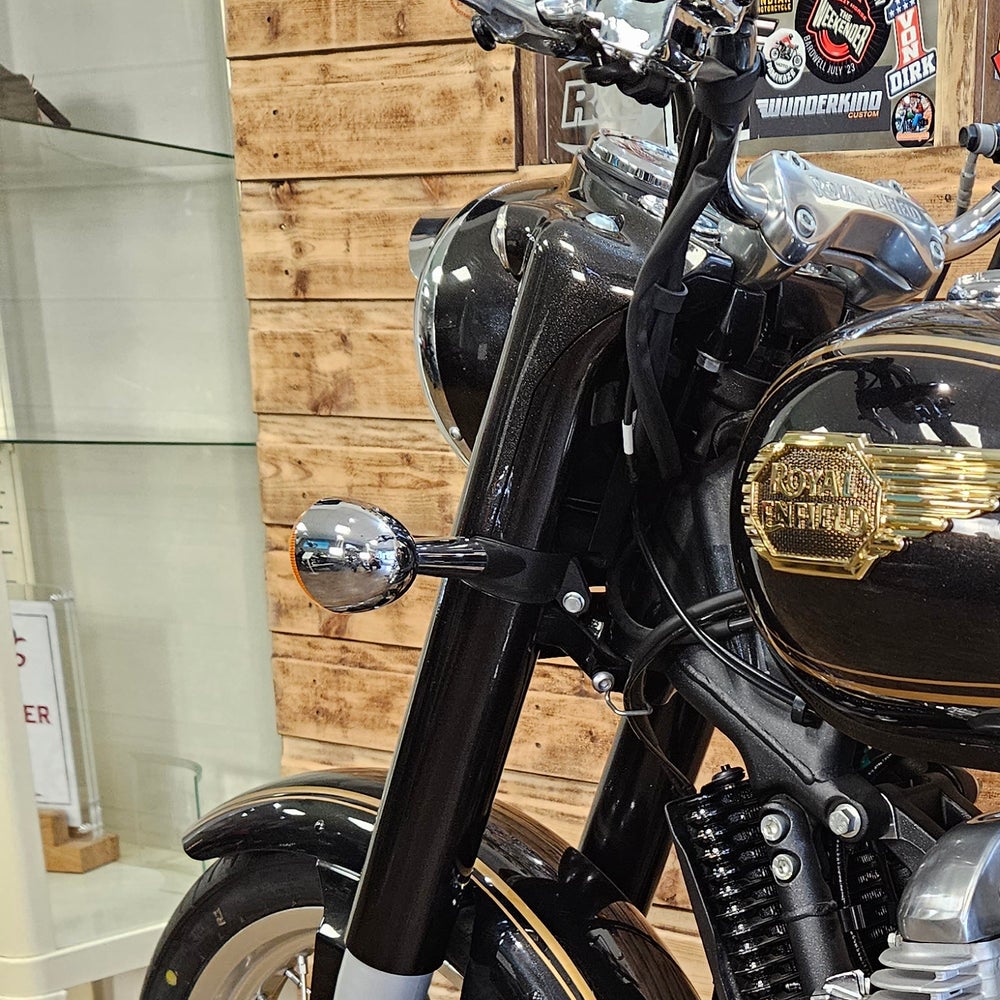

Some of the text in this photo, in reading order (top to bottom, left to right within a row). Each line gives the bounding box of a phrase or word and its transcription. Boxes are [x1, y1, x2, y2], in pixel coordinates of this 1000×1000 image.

[812, 0, 871, 58] WEEKENDER
[840, 9, 853, 22] THE
[896, 7, 920, 65] VON
[804, 35, 827, 72] BARDWELL
[827, 65, 843, 76] JULY
[889, 53, 936, 95] DIRK
[756, 91, 883, 118] WUNDERKIND
[847, 110, 880, 119] CUSTOM
[770, 462, 852, 498] ROYAL
[762, 501, 870, 537] ENFIELD
